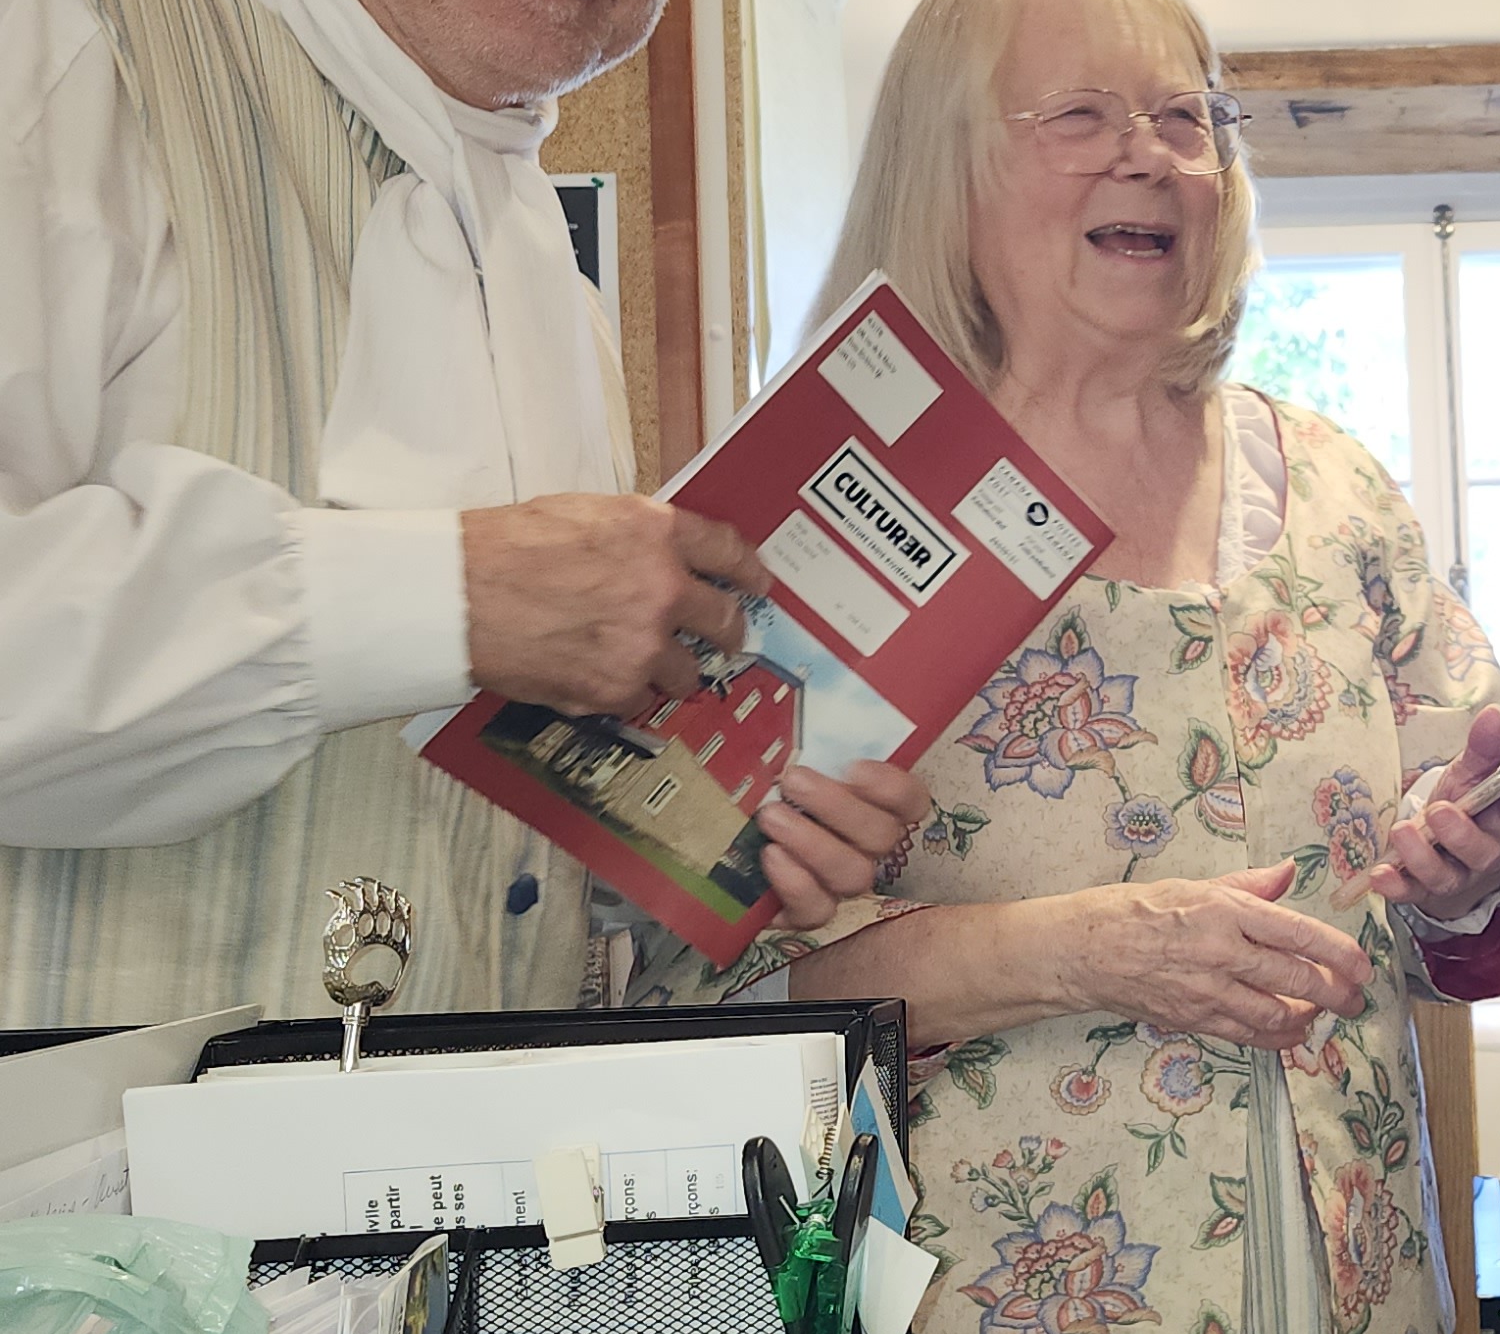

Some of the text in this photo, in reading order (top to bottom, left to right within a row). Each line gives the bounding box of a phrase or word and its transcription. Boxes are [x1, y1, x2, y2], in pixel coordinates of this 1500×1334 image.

[385, 1184, 404, 1229] partir
[428, 1174, 447, 1210] peut
[452, 1182, 465, 1210] ses
